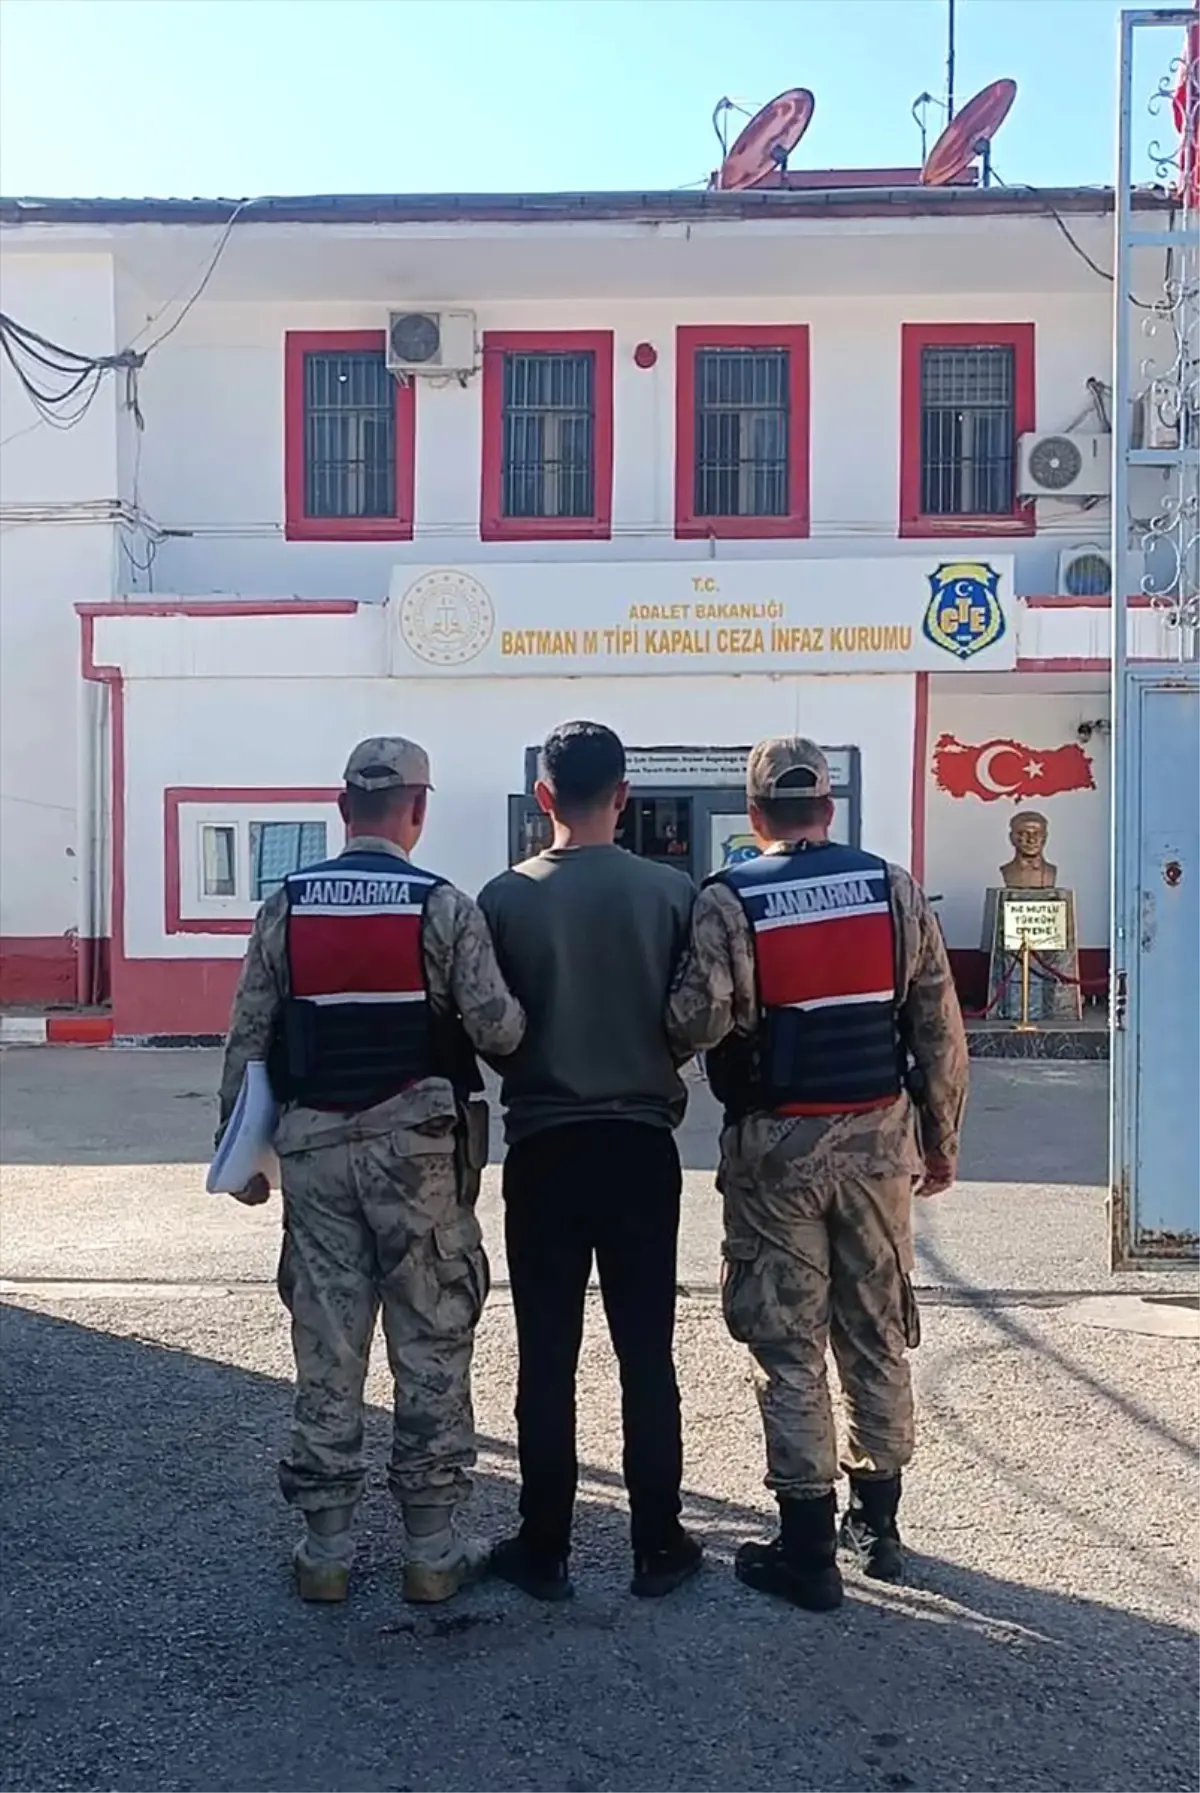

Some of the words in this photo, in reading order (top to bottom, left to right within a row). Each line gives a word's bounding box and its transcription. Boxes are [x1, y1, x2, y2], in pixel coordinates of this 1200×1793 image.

[691, 577, 720, 592] T.C.
[629, 604, 690, 619] ADALET
[695, 600, 784, 619] BAKANLIĞI
[502, 629, 576, 655] BATMAN
[584, 630, 597, 654] M
[604, 624, 638, 654] TİPİ
[645, 628, 709, 654] KAPALI
[716, 627, 765, 653] CEZA
[771, 622, 825, 651] İNFAZ
[830, 625, 912, 651] KURUMU
[300, 881, 410, 904] JANDARMA
[764, 880, 875, 917] JANDARMA
